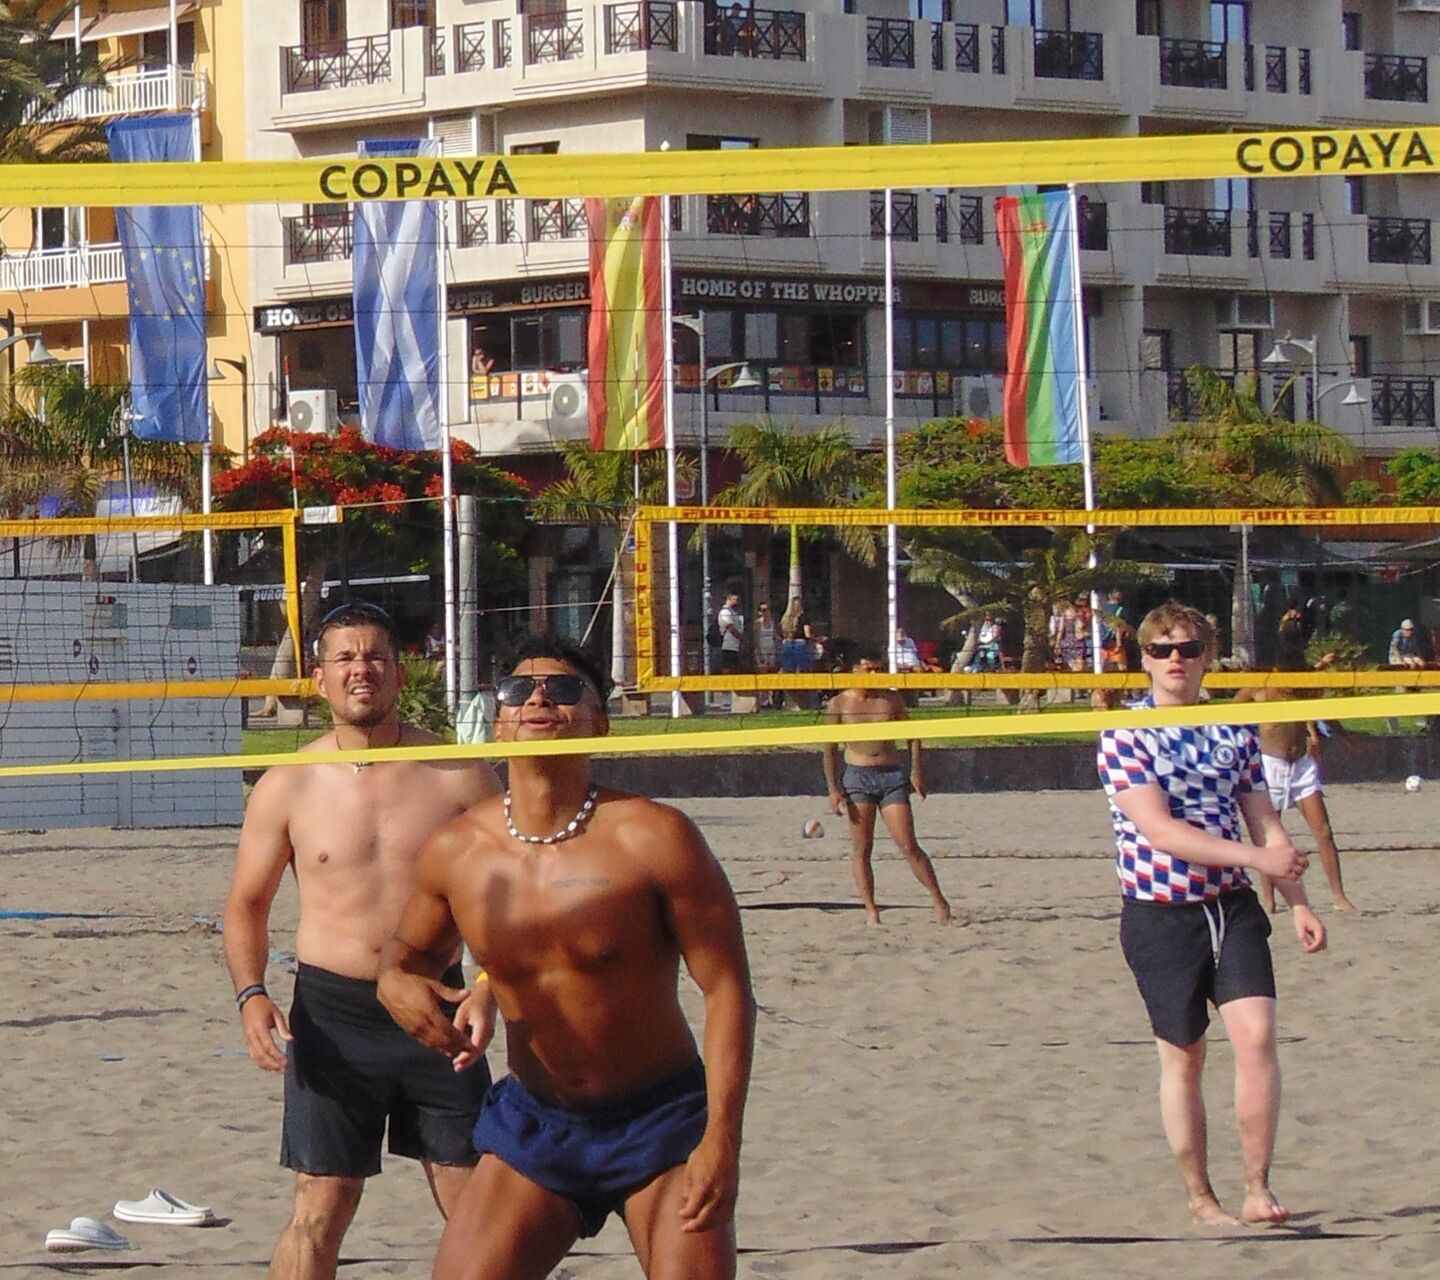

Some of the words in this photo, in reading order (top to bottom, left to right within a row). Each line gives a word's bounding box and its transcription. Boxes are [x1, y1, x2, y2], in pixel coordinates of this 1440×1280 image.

[1236, 131, 1434, 174] COPAYA
[319, 160, 518, 200] COPAYA
[520, 283, 586, 305] BURGER
[682, 278, 737, 296] HOME
[740, 280, 766, 298] OF
[770, 282, 809, 300] THE
